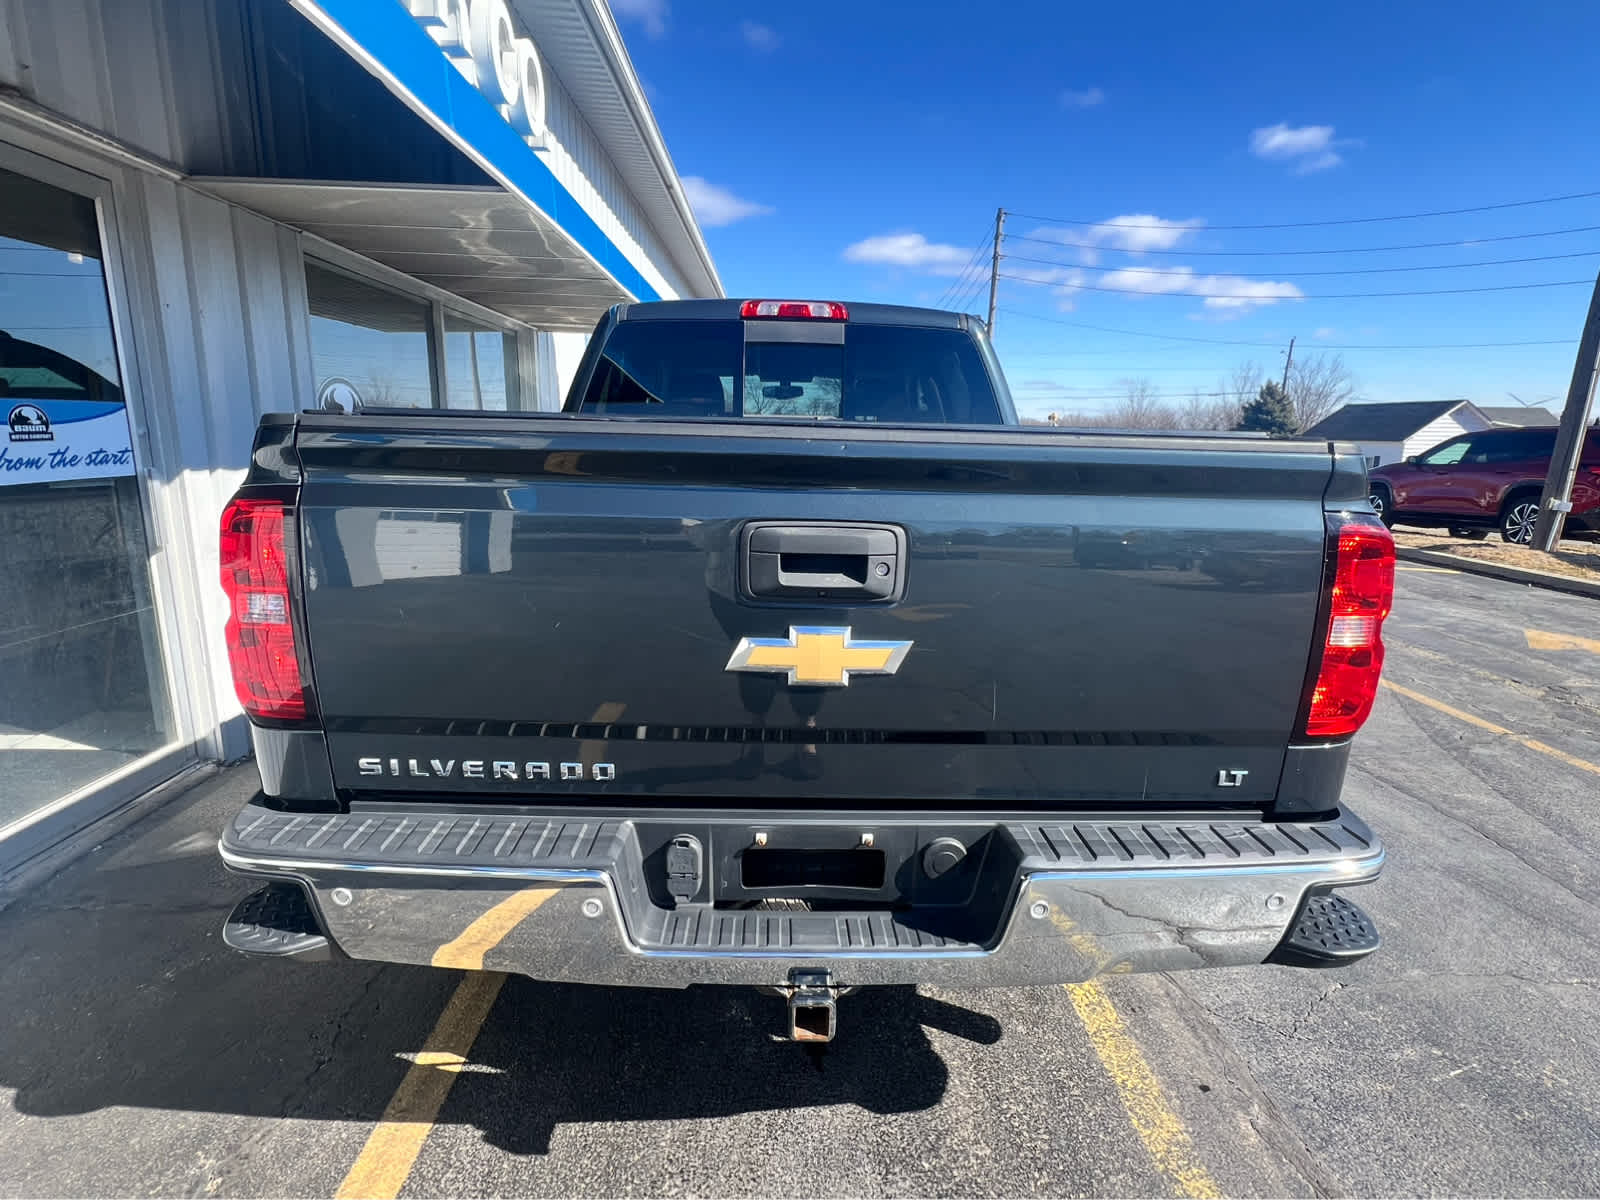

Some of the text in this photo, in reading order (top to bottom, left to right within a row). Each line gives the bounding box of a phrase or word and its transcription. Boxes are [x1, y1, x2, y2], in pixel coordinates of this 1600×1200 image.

[48, 445, 83, 469] the
[84, 447, 132, 466] start.
[358, 757, 617, 781] SILVERADO
[1217, 769, 1249, 786] LT
